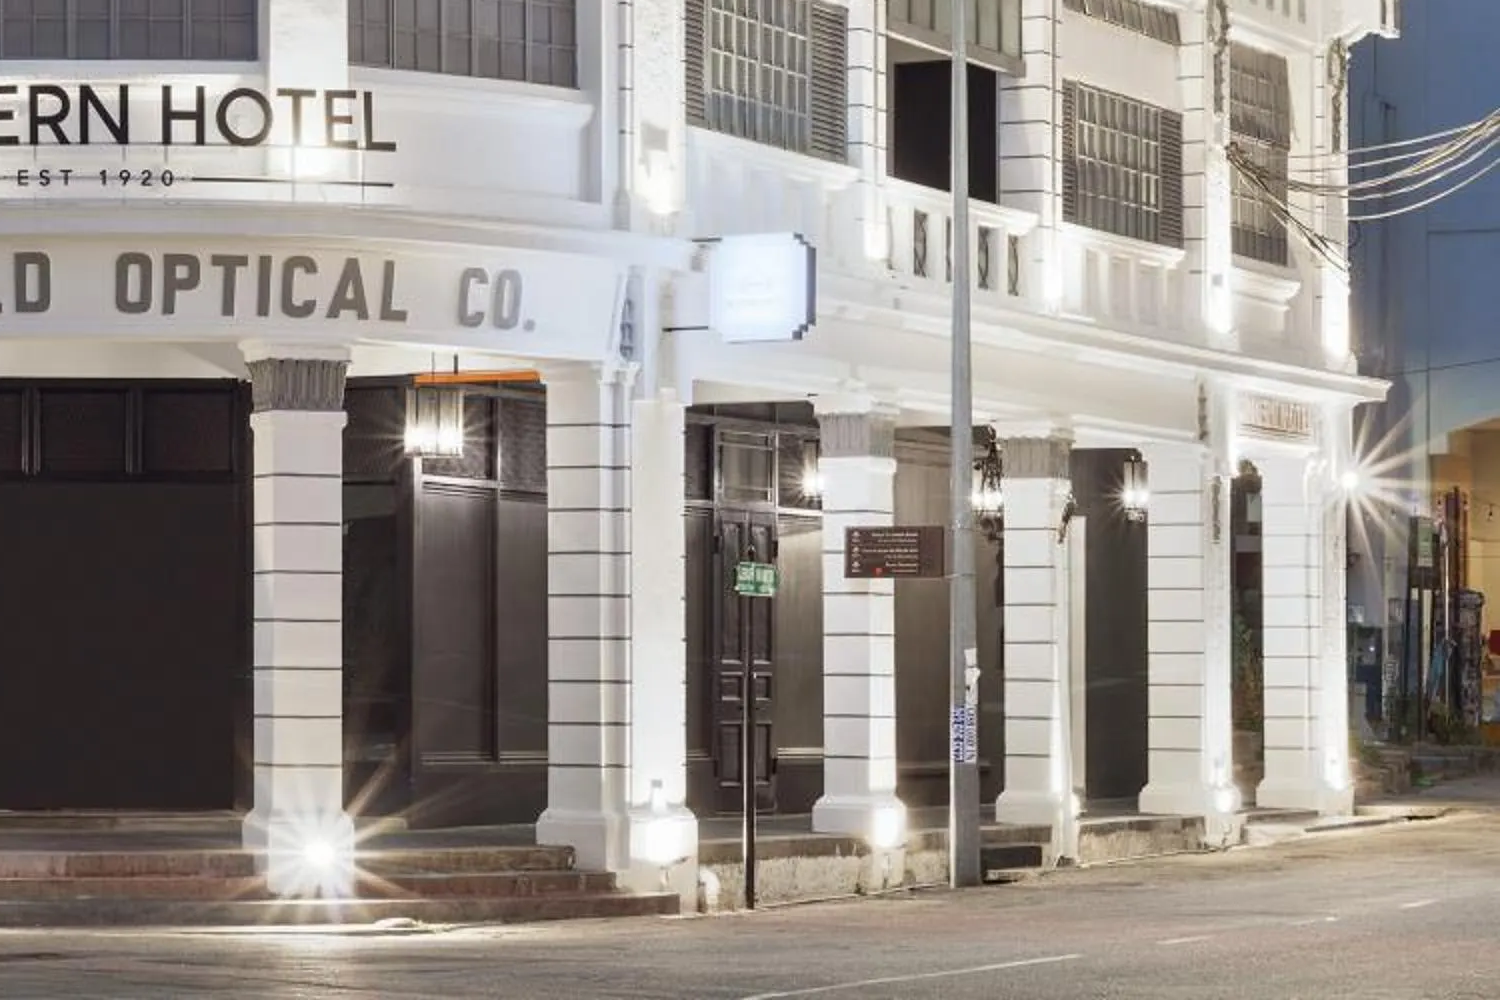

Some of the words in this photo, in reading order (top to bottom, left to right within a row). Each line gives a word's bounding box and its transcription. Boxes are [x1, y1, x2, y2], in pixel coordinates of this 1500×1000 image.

[162, 85, 397, 151] HOTEL
[17, 169, 73, 186] EST
[100, 169, 174, 187] 1920
[115, 251, 407, 322] OPTICAL
[458, 267, 536, 331] CO.
